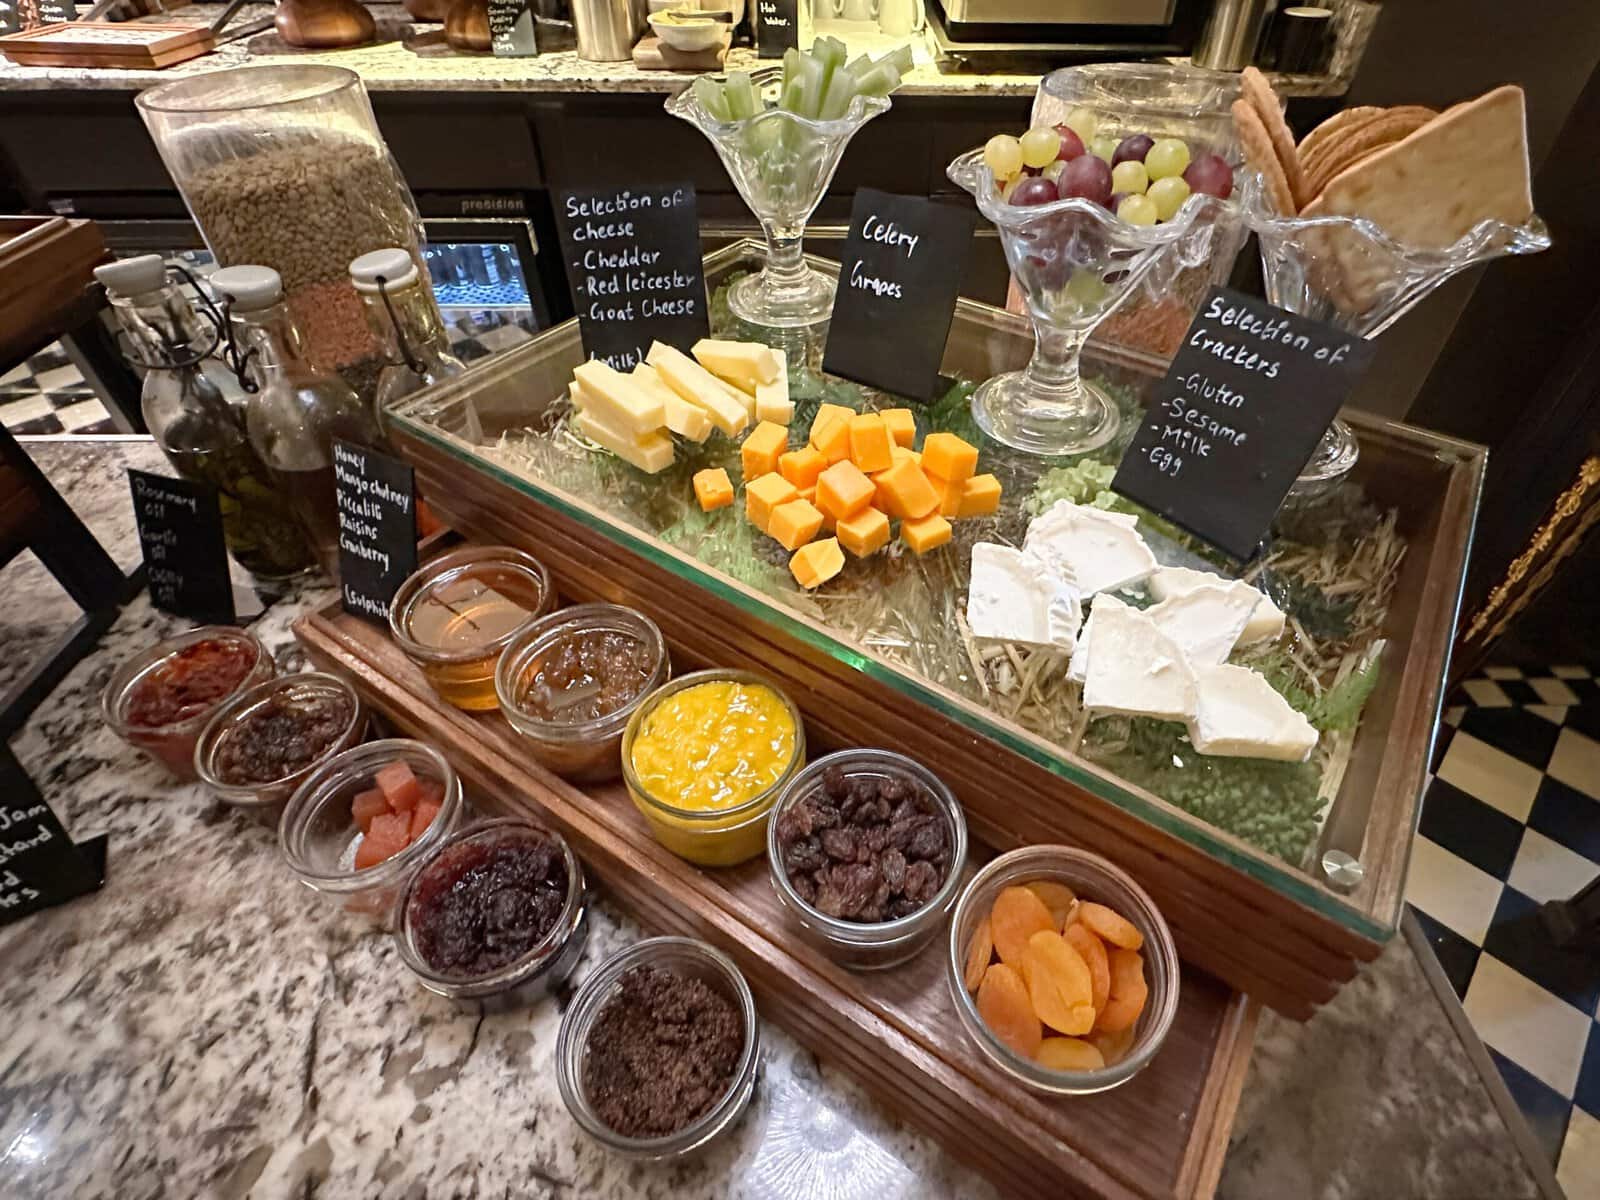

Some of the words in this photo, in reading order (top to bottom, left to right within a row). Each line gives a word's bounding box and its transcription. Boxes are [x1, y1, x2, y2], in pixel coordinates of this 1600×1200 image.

[760, 2, 776, 13] Hot
[461, 199, 524, 214] precision
[566, 191, 651, 218] Selection
[661, 189, 683, 208] of
[572, 221, 634, 241] cheese
[862, 215, 919, 258] Celery
[850, 260, 902, 298] Grapes
[642, 298, 695, 317] Cheese
[1204, 296, 1310, 350] Selection
[1313, 343, 1351, 365] of
[1190, 328, 1281, 378] Crackers
[334, 444, 365, 475] Honey
[335, 464, 369, 494] Mango
[339, 512, 378, 540] Raisins
[340, 533, 389, 572] Cranberry
